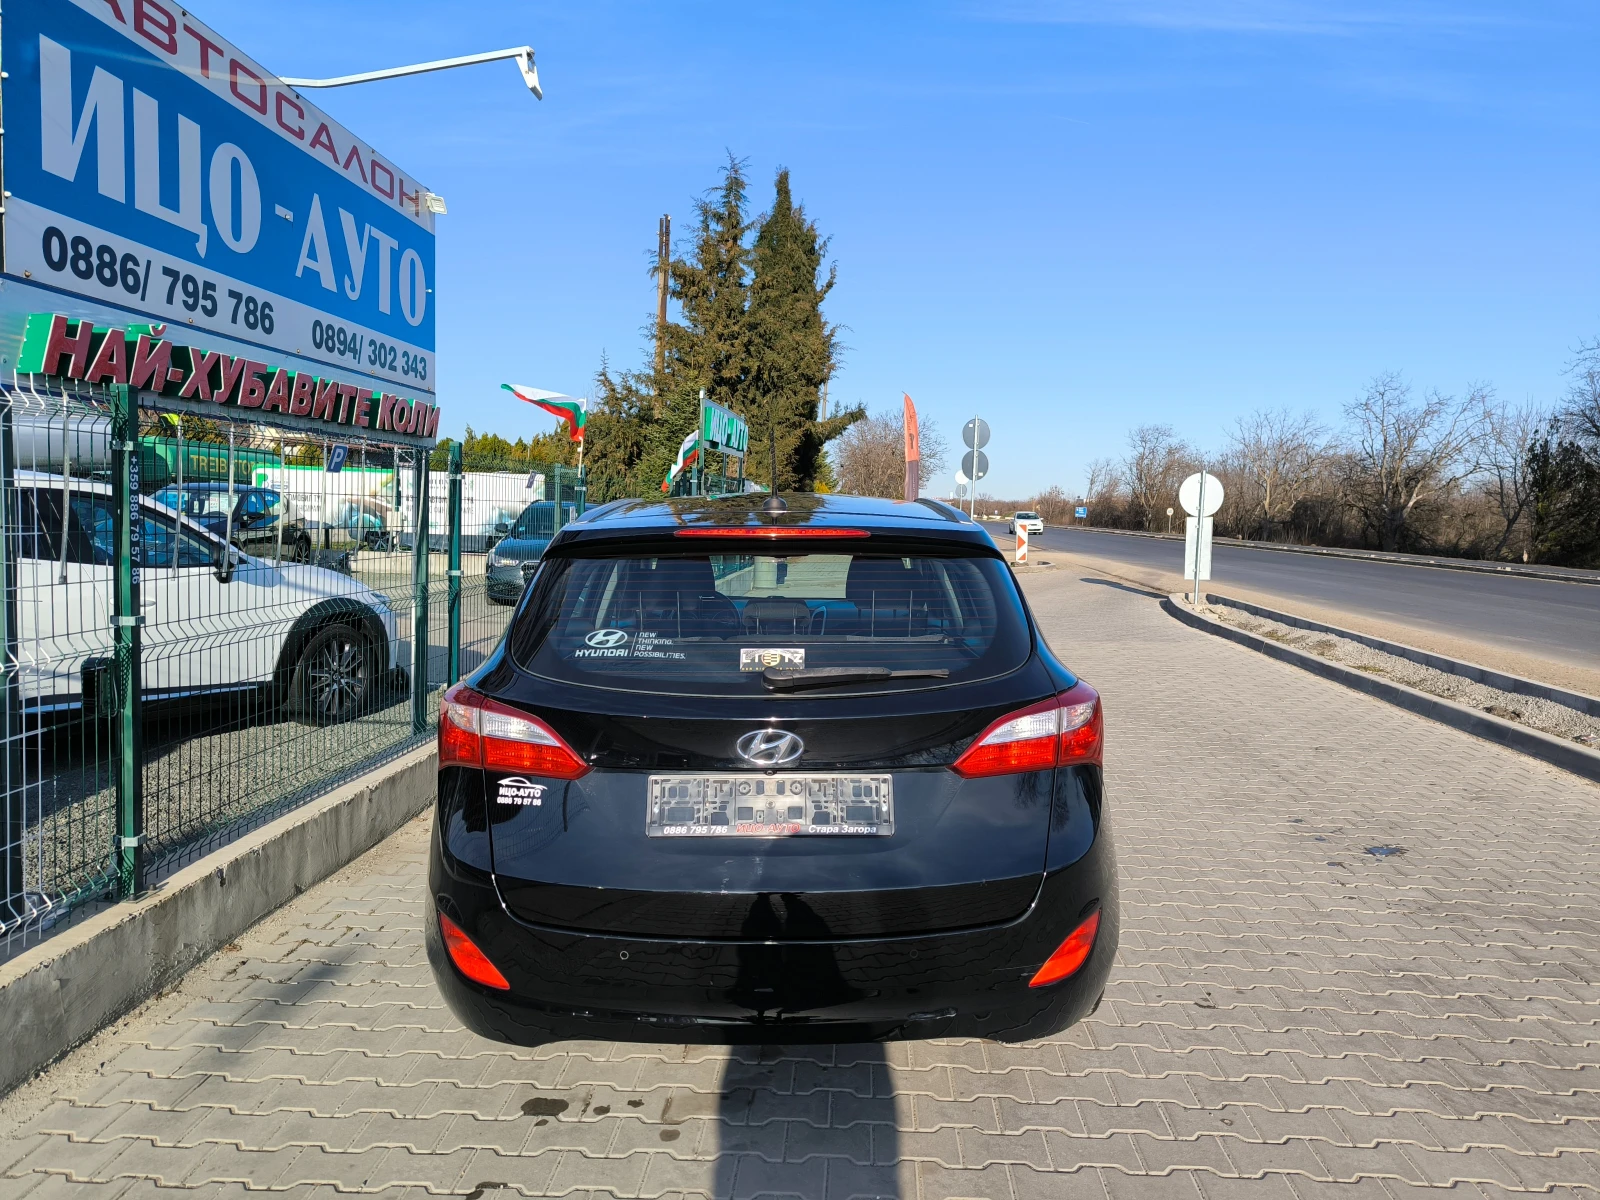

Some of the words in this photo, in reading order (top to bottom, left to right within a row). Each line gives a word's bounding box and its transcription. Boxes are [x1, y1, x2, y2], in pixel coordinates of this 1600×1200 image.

[42, 226, 151, 301] 0886/
[161, 265, 218, 317] 795
[228, 289, 274, 335] 786
[311, 319, 363, 364] 0894/
[368, 338, 398, 373] 302
[401, 350, 428, 381] 343
[41, 313, 374, 428] НАЙ-ХУБАВИТЕ
[376, 391, 441, 438] КОЛИ
[130, 455, 139, 491] +359
[130, 495, 139, 521] 886
[130, 526, 140, 542] 79
[131, 549, 141, 562] 57
[132, 567, 141, 584] 86
[574, 648, 629, 658] HYUNDAI
[498, 787, 541, 797] ИЦО-АУТО
[663, 825, 688, 835] 0886
[689, 825, 708, 834] 795
[710, 825, 728, 834] 786
[808, 824, 840, 834] Стара
[841, 824, 877, 835] Загора
